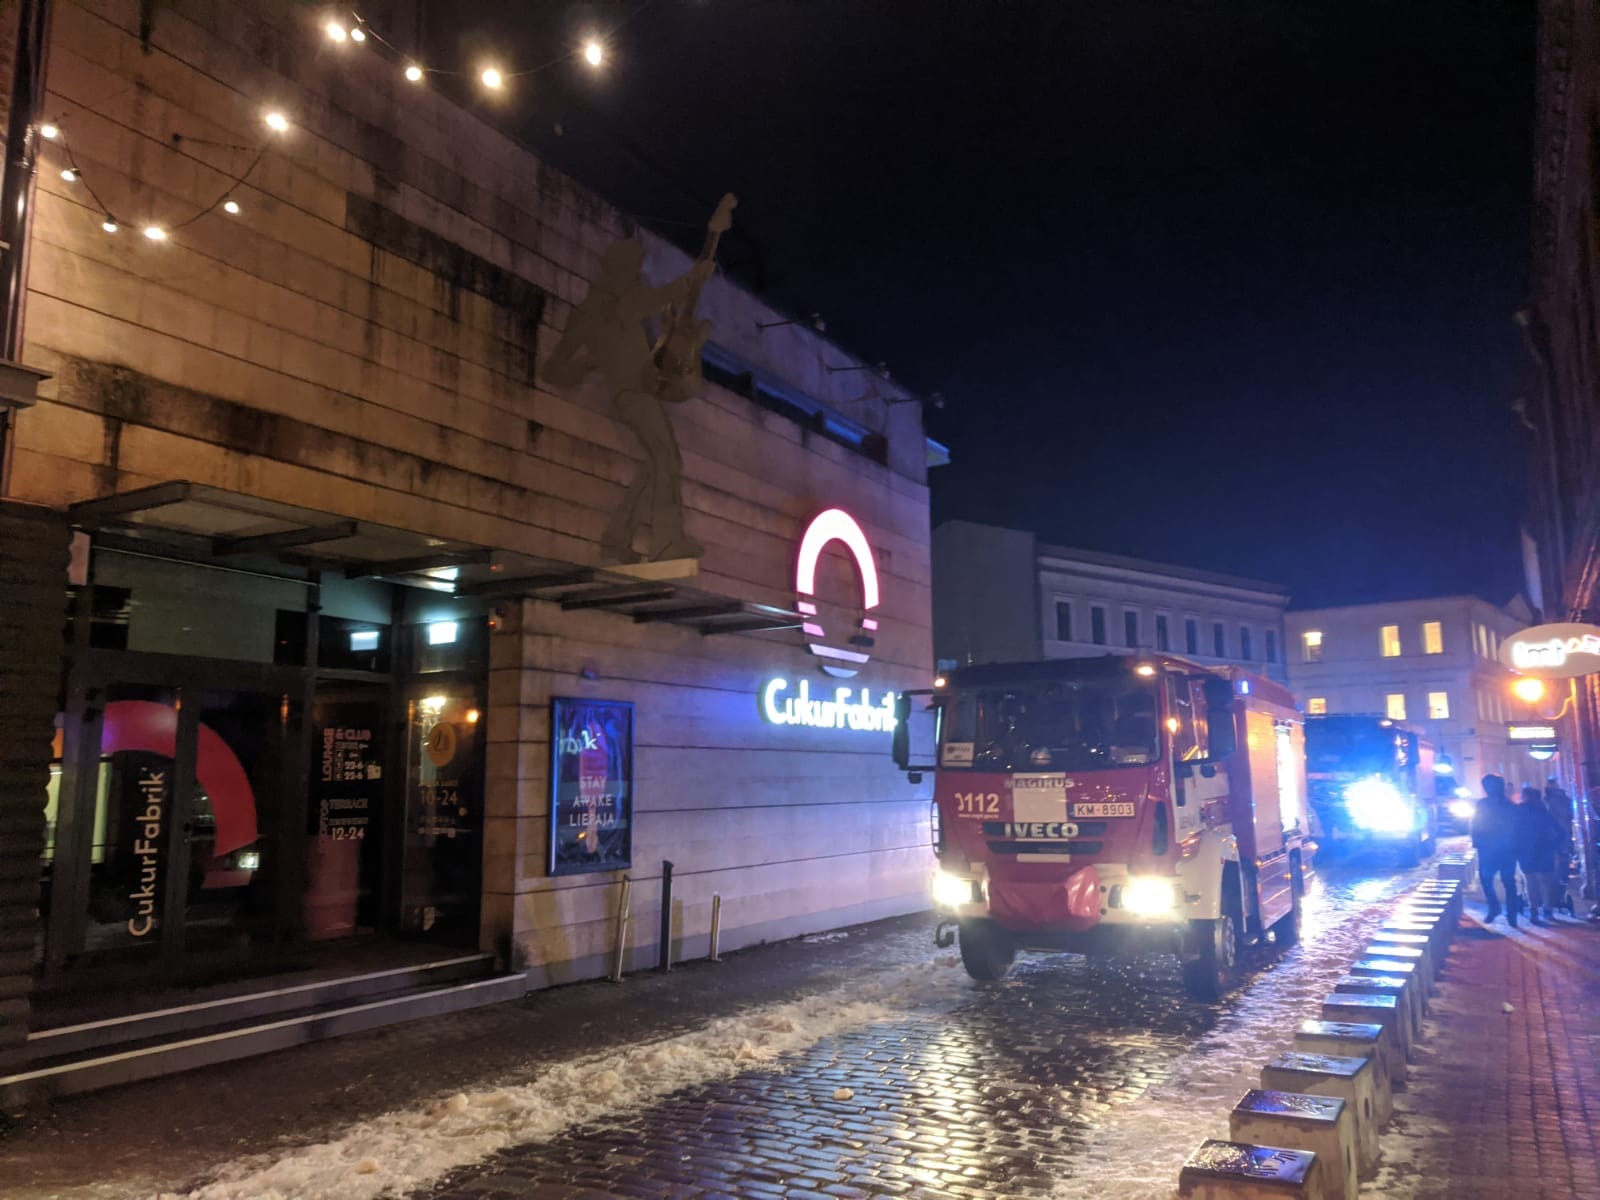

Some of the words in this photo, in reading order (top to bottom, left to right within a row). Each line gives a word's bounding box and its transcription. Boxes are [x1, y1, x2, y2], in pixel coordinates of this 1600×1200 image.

[580, 776, 607, 790] STAY
[1004, 778, 1075, 789] MAGIRUS
[572, 793, 612, 808] AWAKE
[964, 792, 999, 813] 112
[331, 826, 365, 841] 12-24
[1005, 822, 1079, 838] IVECO
